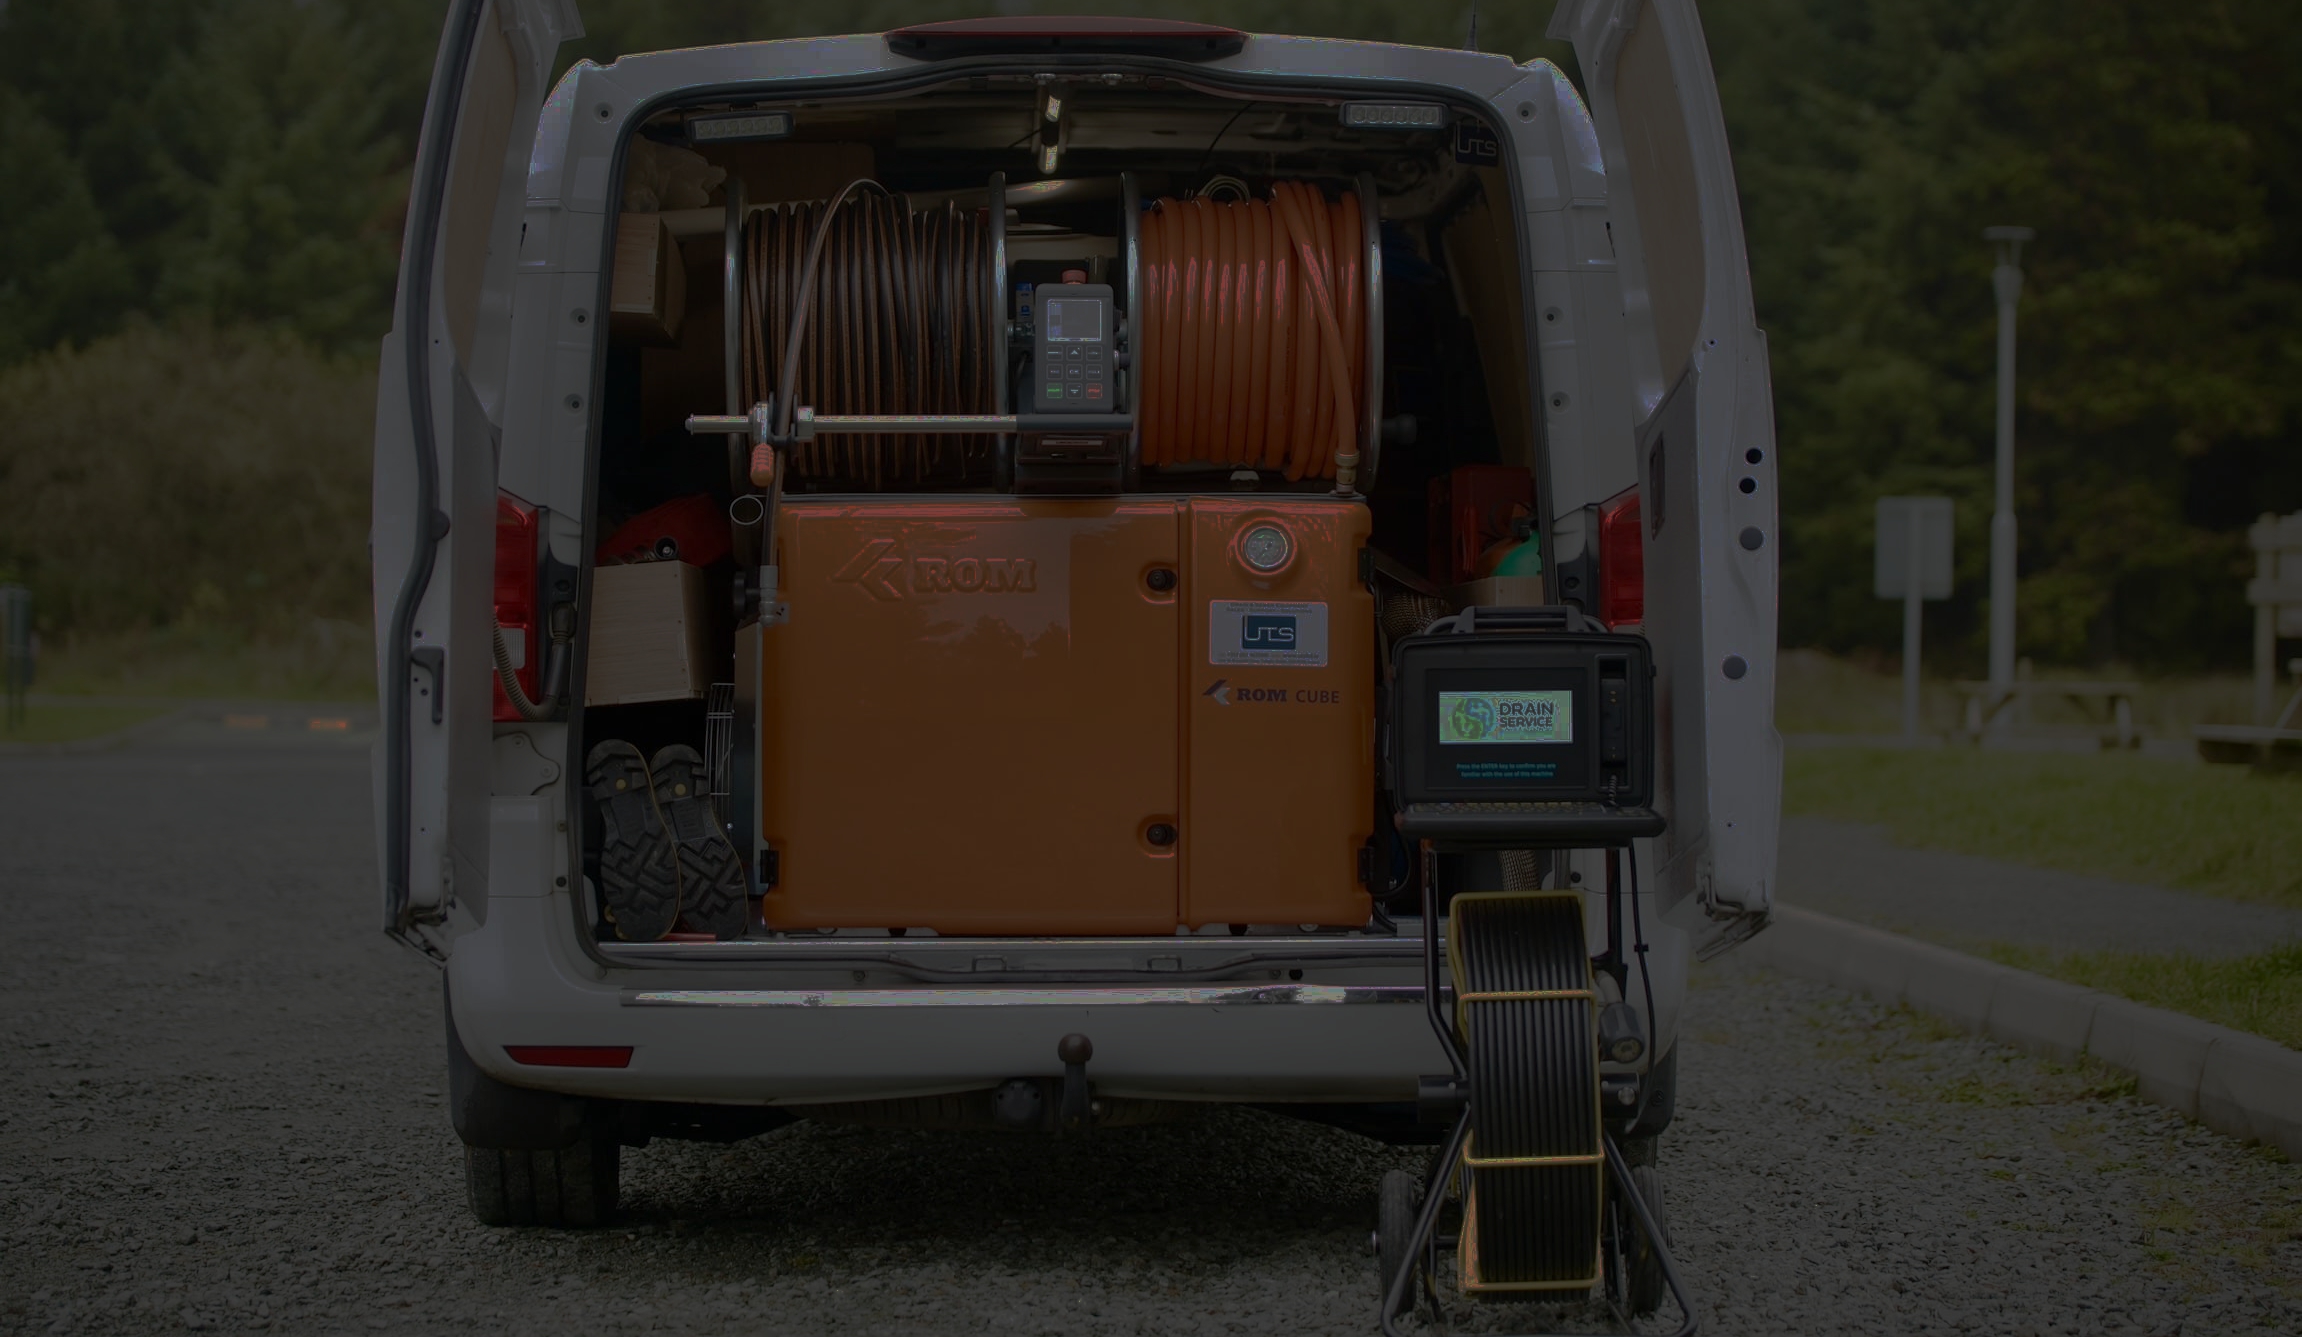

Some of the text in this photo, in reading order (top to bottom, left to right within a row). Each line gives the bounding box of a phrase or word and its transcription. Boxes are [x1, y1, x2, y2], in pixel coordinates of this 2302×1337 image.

[1456, 122, 1497, 156] UTS
[914, 557, 1037, 593] ROM
[1244, 615, 1294, 642] UTS
[1236, 688, 1340, 703] ROM CUBE
[1499, 702, 1553, 716] DRAIN
[1499, 716, 1552, 727] SERVICE
